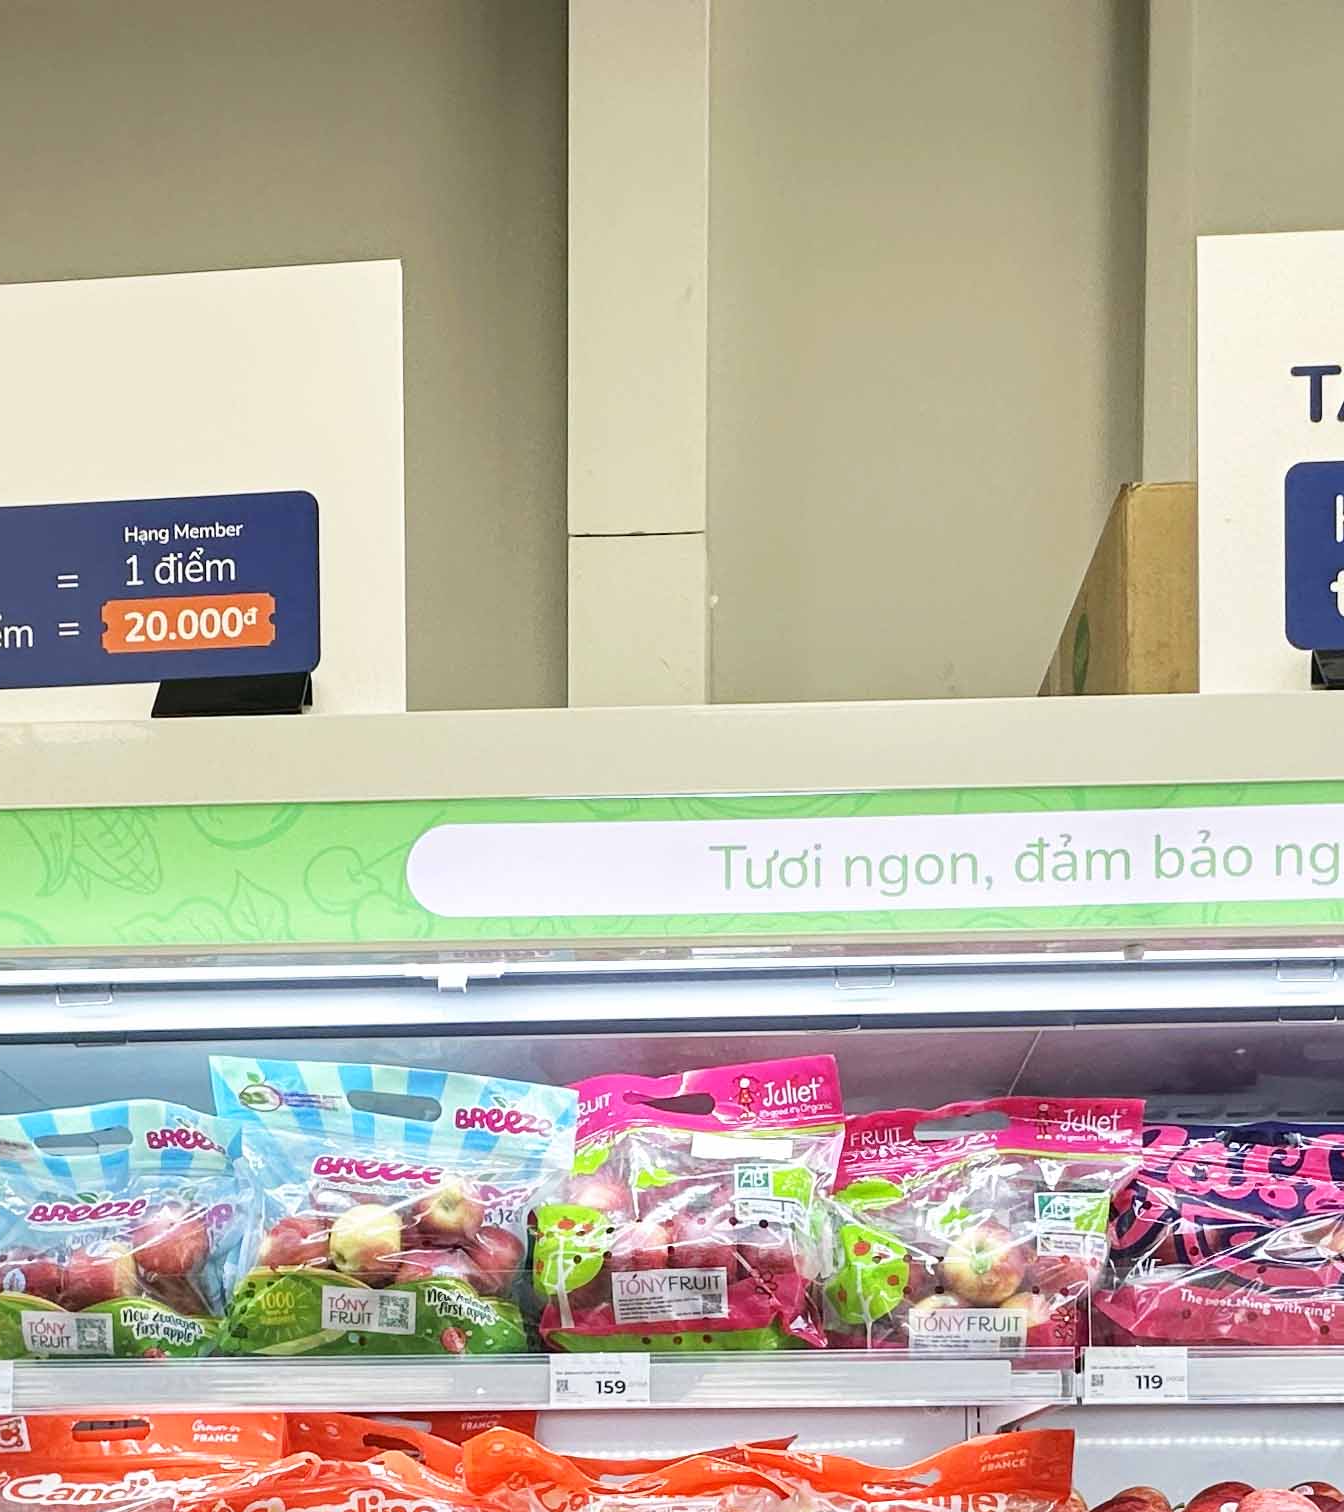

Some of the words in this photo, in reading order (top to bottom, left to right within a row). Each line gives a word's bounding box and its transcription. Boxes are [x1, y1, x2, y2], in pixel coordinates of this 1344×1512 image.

[123, 523, 169, 545] Hạng
[173, 520, 243, 542] Member
[125, 554, 143, 586] 1
[154, 547, 236, 586] điểm
[709, 841, 823, 891] Tươi
[843, 844, 994, 895] ngon,
[1013, 834, 1133, 884] đảm
[1152, 828, 1256, 881] bảo
[762, 1079, 820, 1108] Juliet
[1059, 1108, 1121, 1133] Juliet
[849, 1127, 903, 1147] FRUIT
[328, 1293, 369, 1312] TÓNY
[1274, 1300, 1302, 1314] with
[29, 1318, 66, 1335] TÓNY
[329, 1311, 373, 1326] FRUIT
[31, 1334, 72, 1349] FRUIT
[596, 1380, 626, 1395] 159
[1135, 1374, 1163, 1390] 119
[193, 1433, 238, 1443] FRANCE
